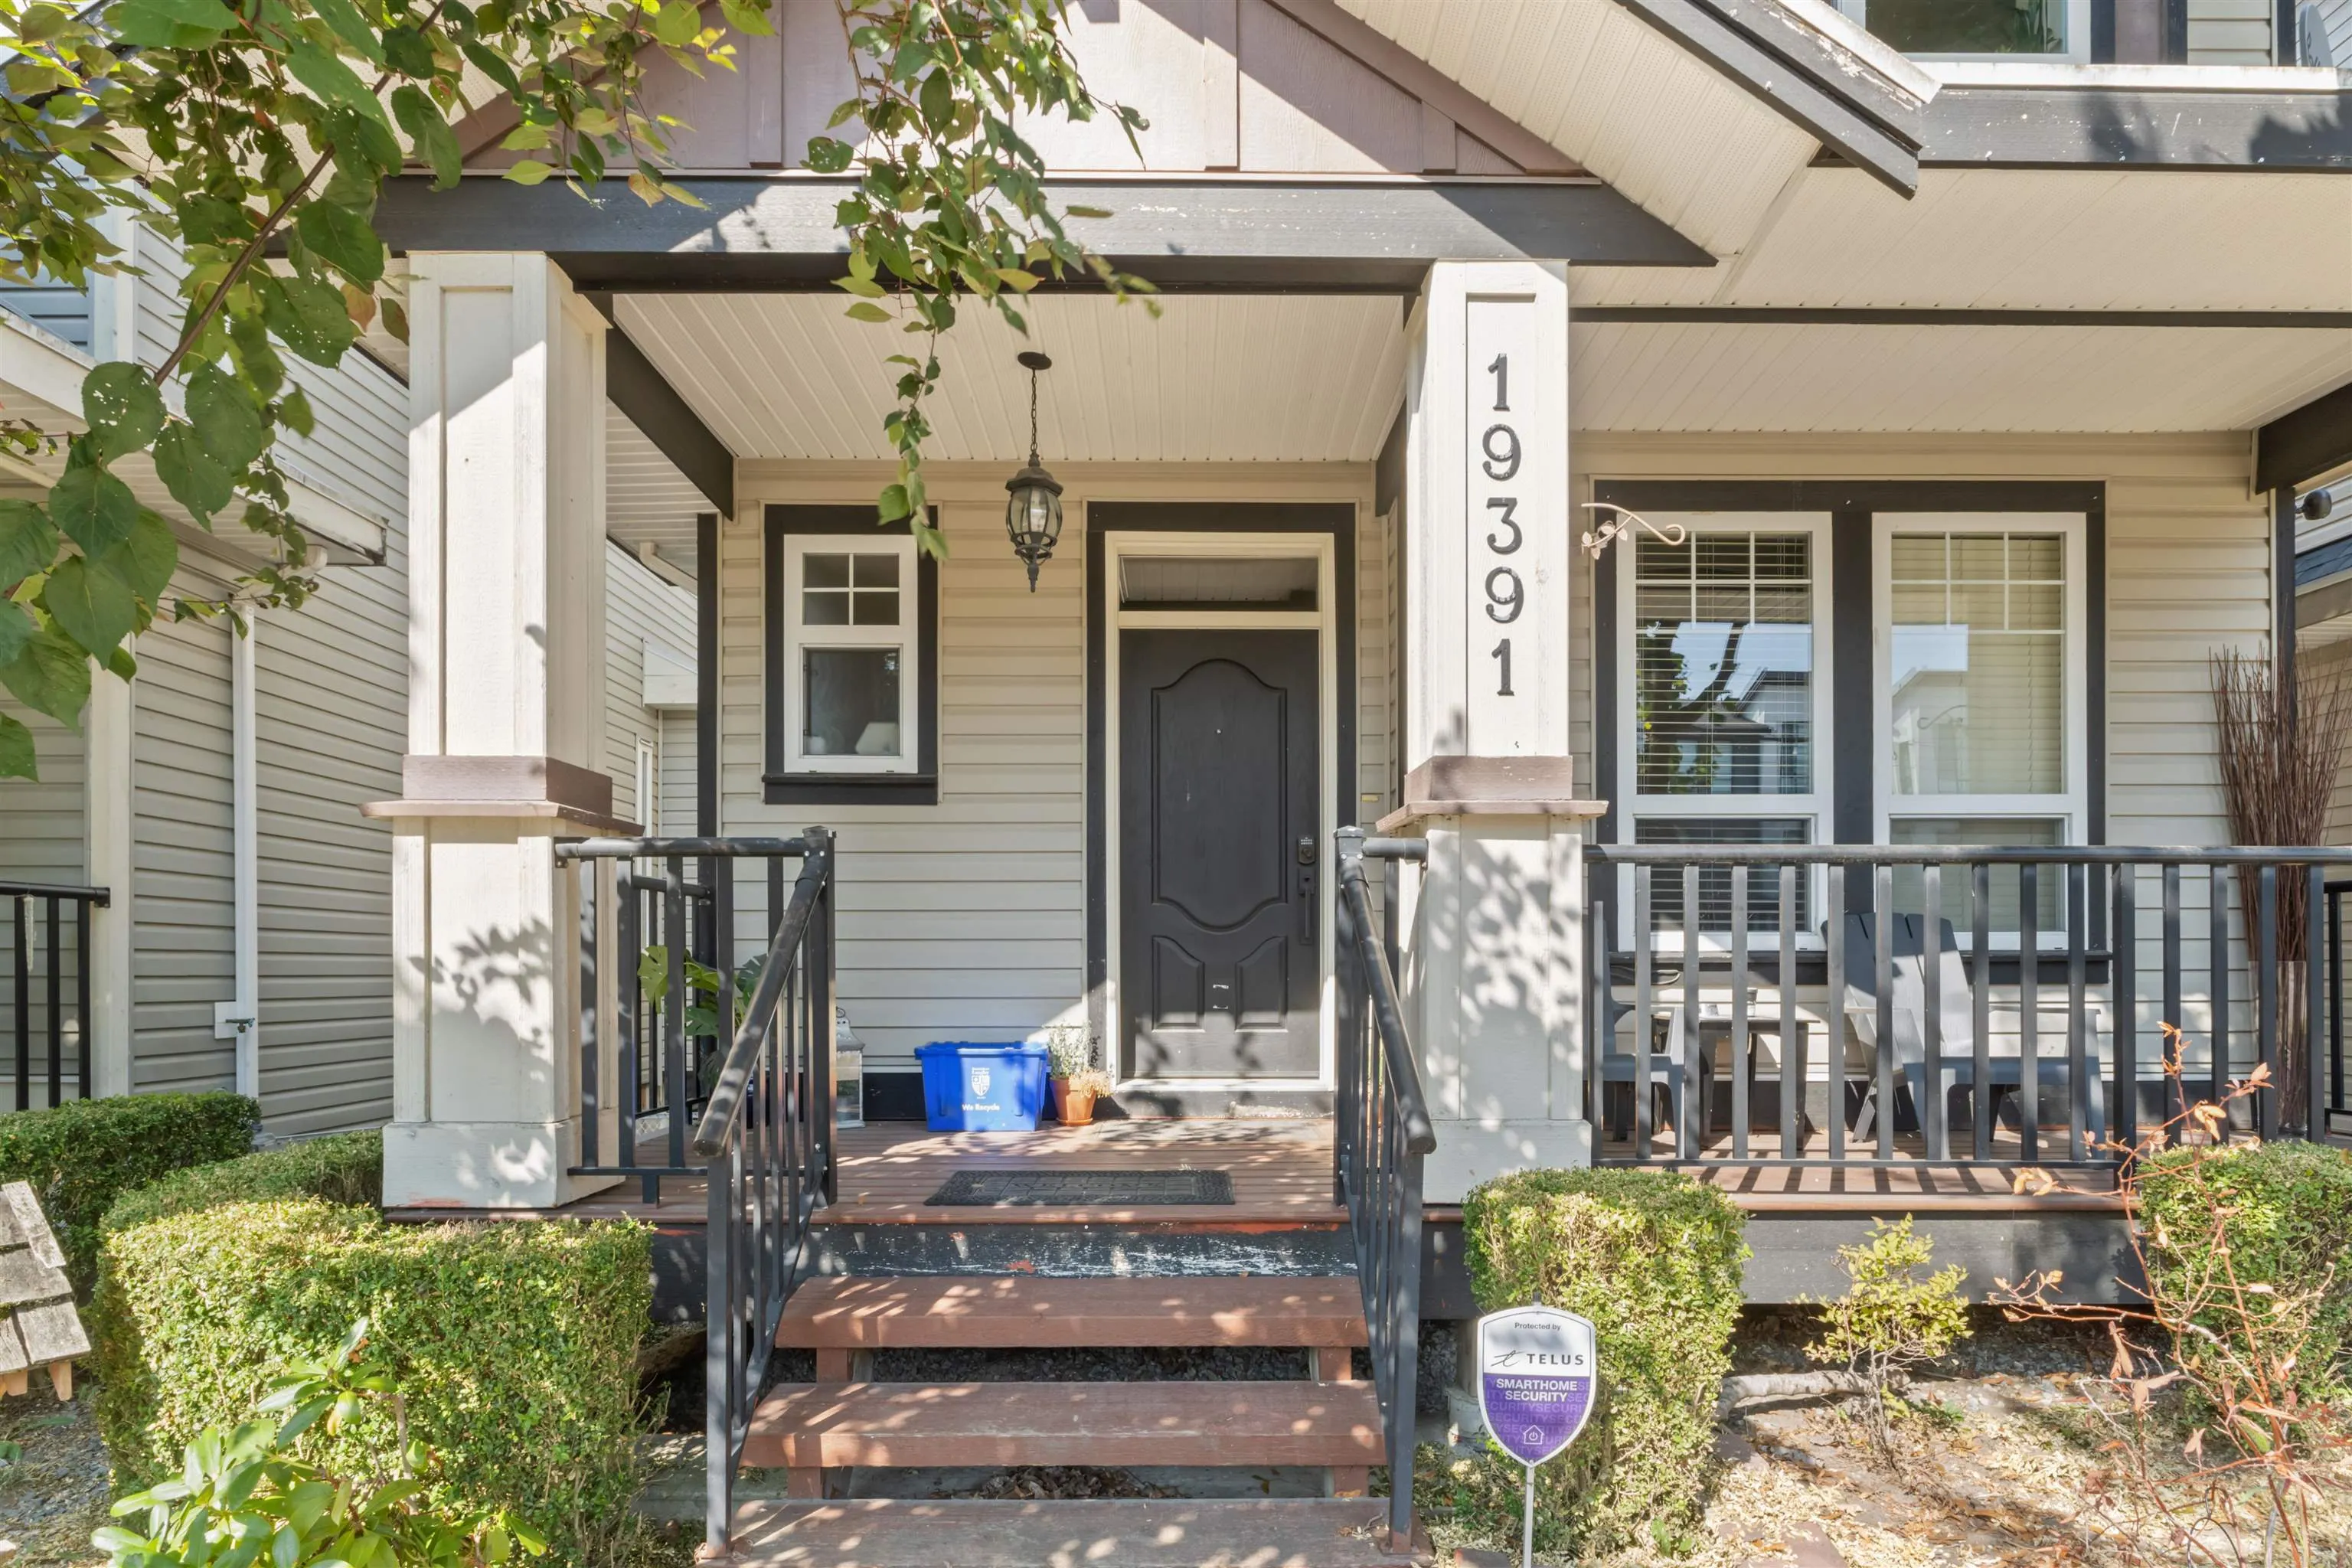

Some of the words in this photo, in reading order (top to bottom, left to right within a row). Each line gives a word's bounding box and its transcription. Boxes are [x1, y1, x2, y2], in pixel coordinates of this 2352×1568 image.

[1482, 353, 1524, 697] 19391
[1526, 1353, 1584, 1366] TELUS
[1496, 1378, 1577, 1391] SMARTHOME
[1504, 1390, 1568, 1403] SECURITY
